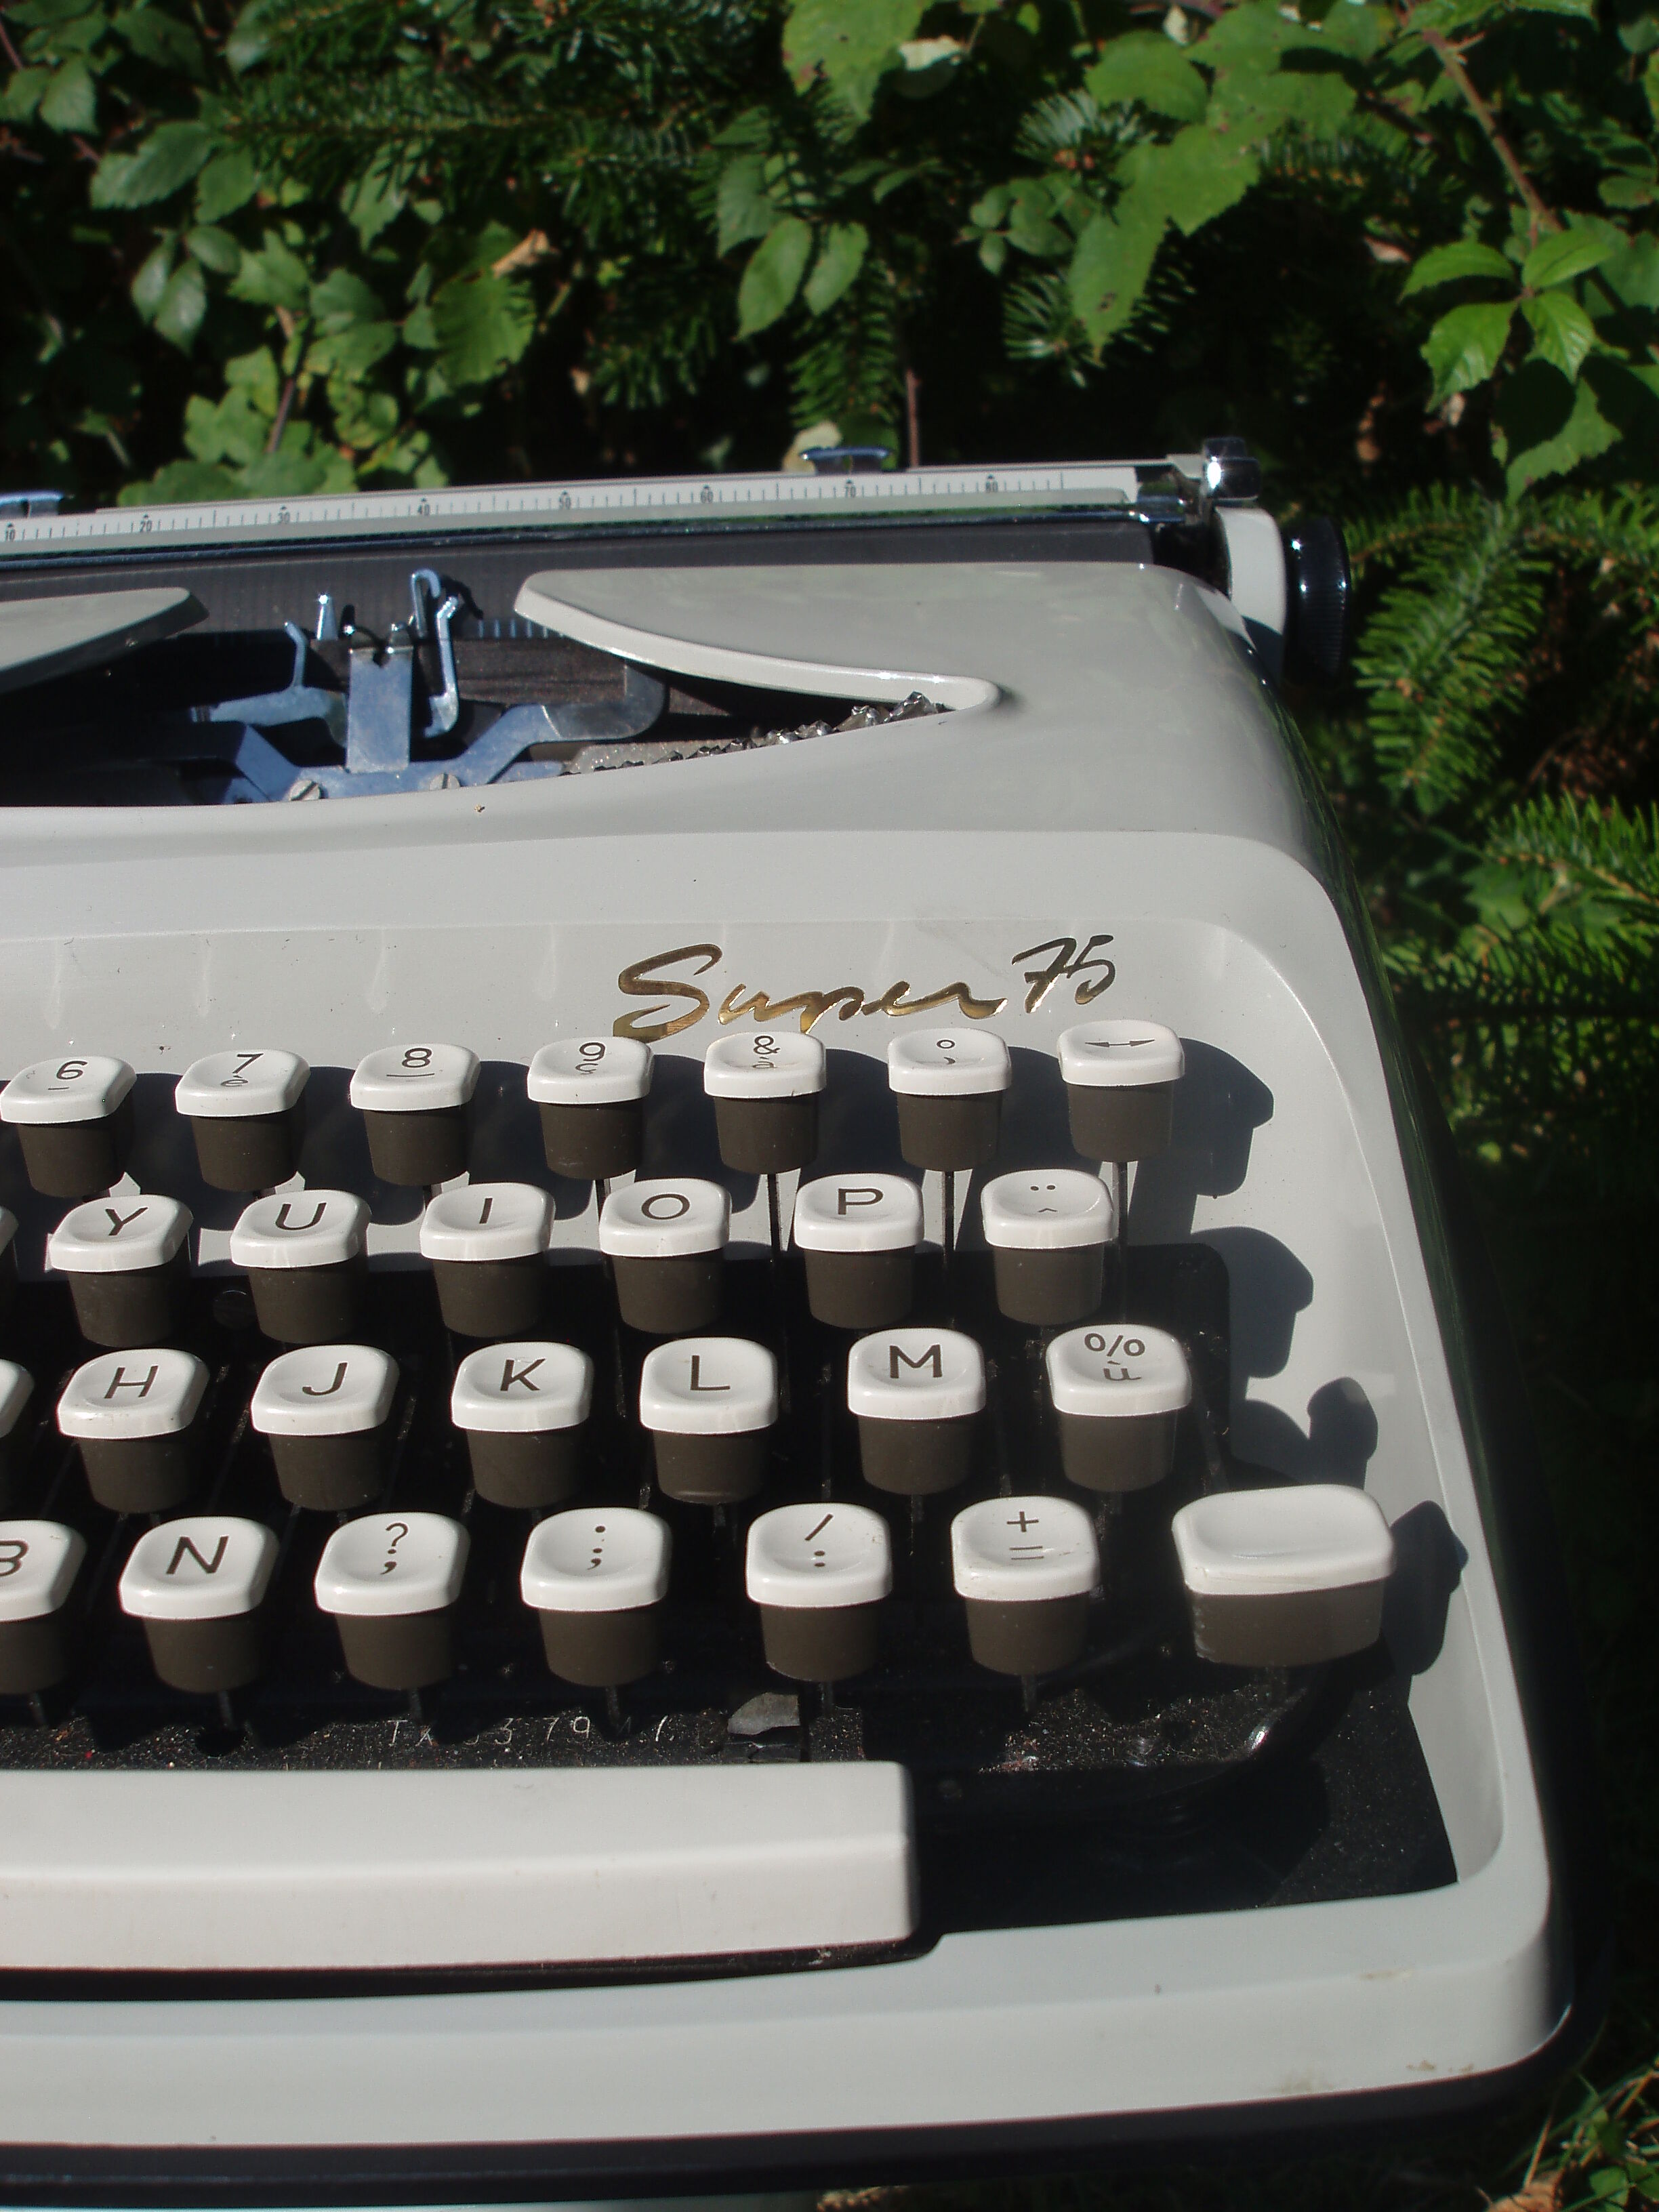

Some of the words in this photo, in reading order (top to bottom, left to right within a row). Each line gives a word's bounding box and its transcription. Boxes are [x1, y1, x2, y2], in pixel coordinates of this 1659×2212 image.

[5, 529, 16, 541] 10
[140, 519, 152, 532] 20
[279, 511, 290, 524] 30
[417, 504, 430, 516] 40
[558, 496, 571, 509] 50
[700, 490, 713, 503] 60
[845, 485, 857, 497] 70
[985, 480, 998, 493] 80
[613, 943, 1008, 1042] Super
[1012, 934, 1115, 1013] 75
[401, 1048, 432, 1068] 8
[579, 1042, 605, 1062] 9
[753, 1035, 781, 1054] &
[56, 1061, 87, 1080] 6
[232, 1052, 264, 1073] 7
[478, 1197, 493, 1224] I
[640, 1193, 691, 1220] O
[838, 1188, 883, 1215] P
[104, 1207, 148, 1236] Y
[274, 1202, 327, 1231] U
[1084, 1332, 1145, 1357] %
[499, 1358, 547, 1391] K
[690, 1355, 731, 1391] L
[890, 1345, 943, 1378] M
[104, 1365, 159, 1399] H
[302, 1362, 348, 1396] J
[1006, 1511, 1039, 1532] +
[385, 1522, 409, 1554] ?
[166, 1536, 228, 1575] N
